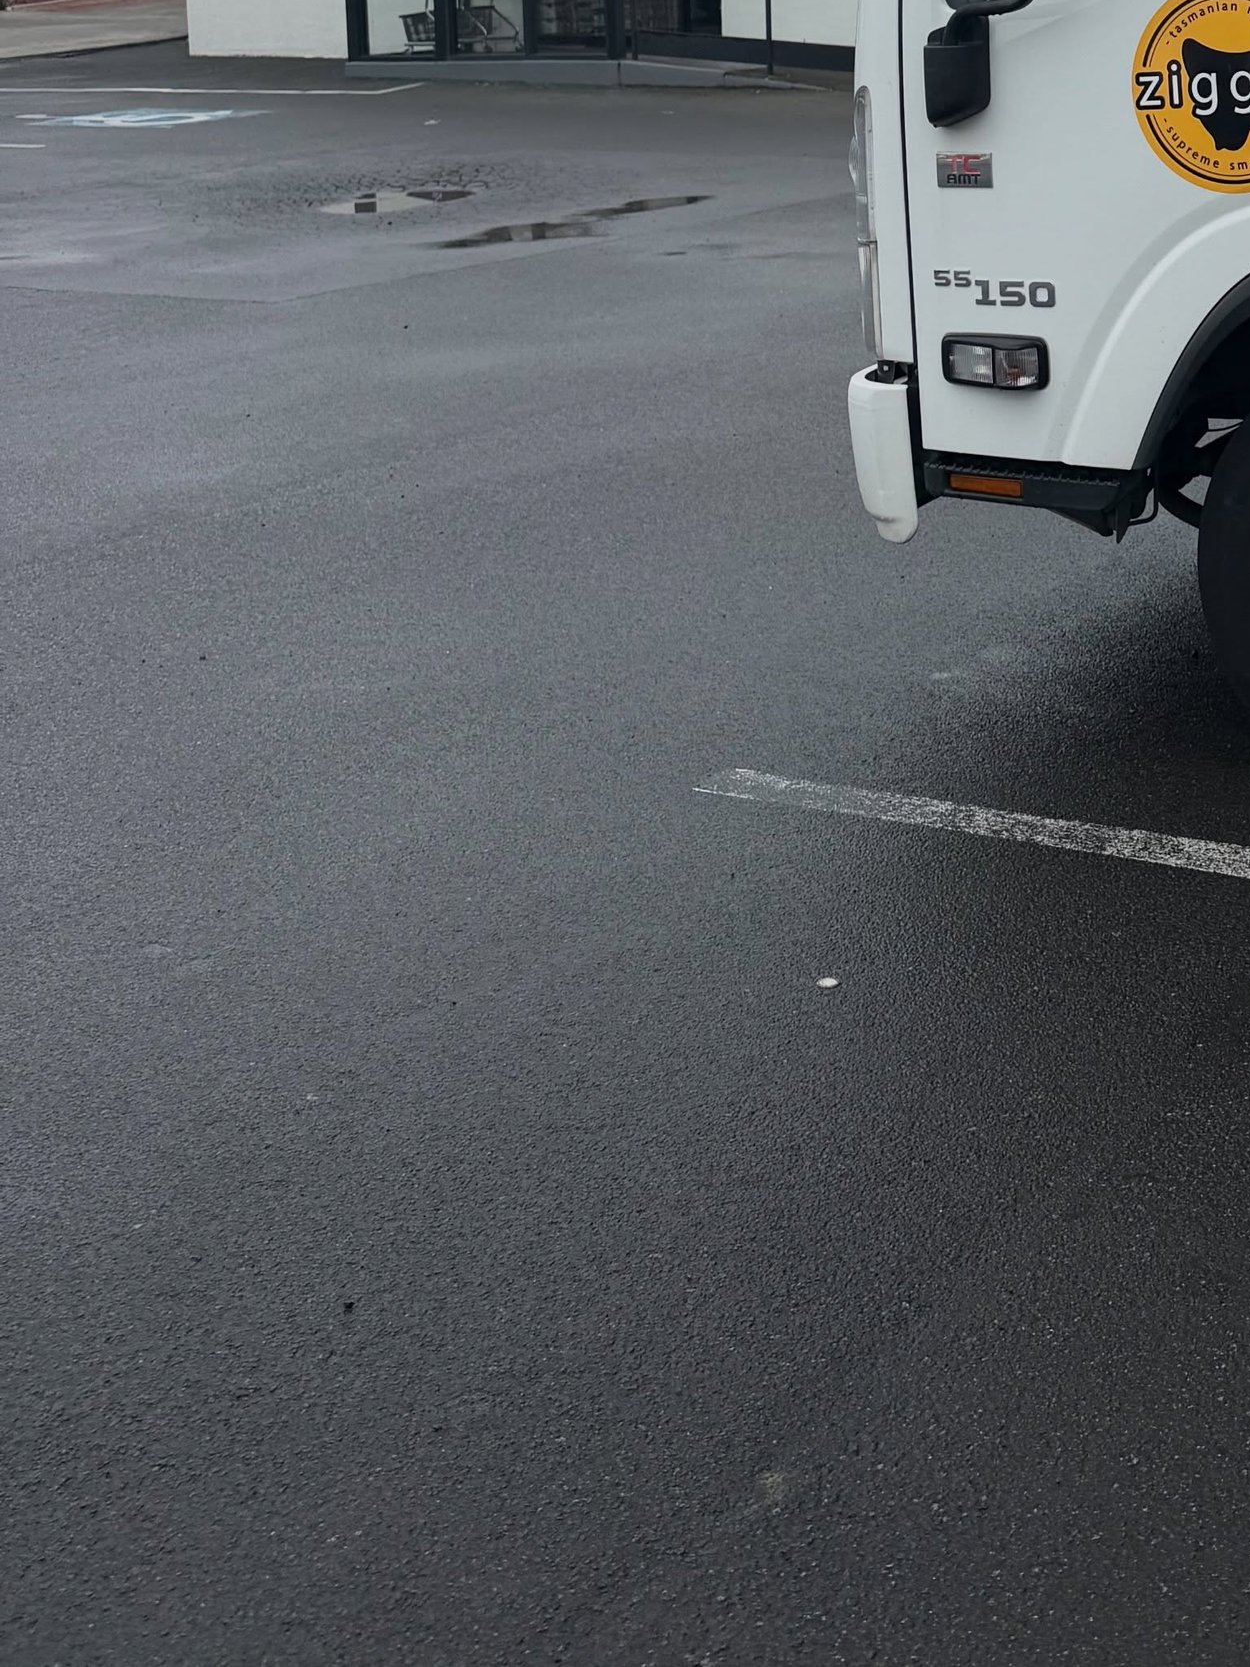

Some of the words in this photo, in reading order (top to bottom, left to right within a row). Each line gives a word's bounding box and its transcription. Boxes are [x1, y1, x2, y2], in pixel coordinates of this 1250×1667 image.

[1168, 1, 1238, 39] tasmanian
[945, 155, 981, 174] TC
[1166, 124, 1220, 168] supreme
[946, 174, 981, 185] AMT
[933, 269, 972, 288] 55
[974, 279, 1056, 308] 150
